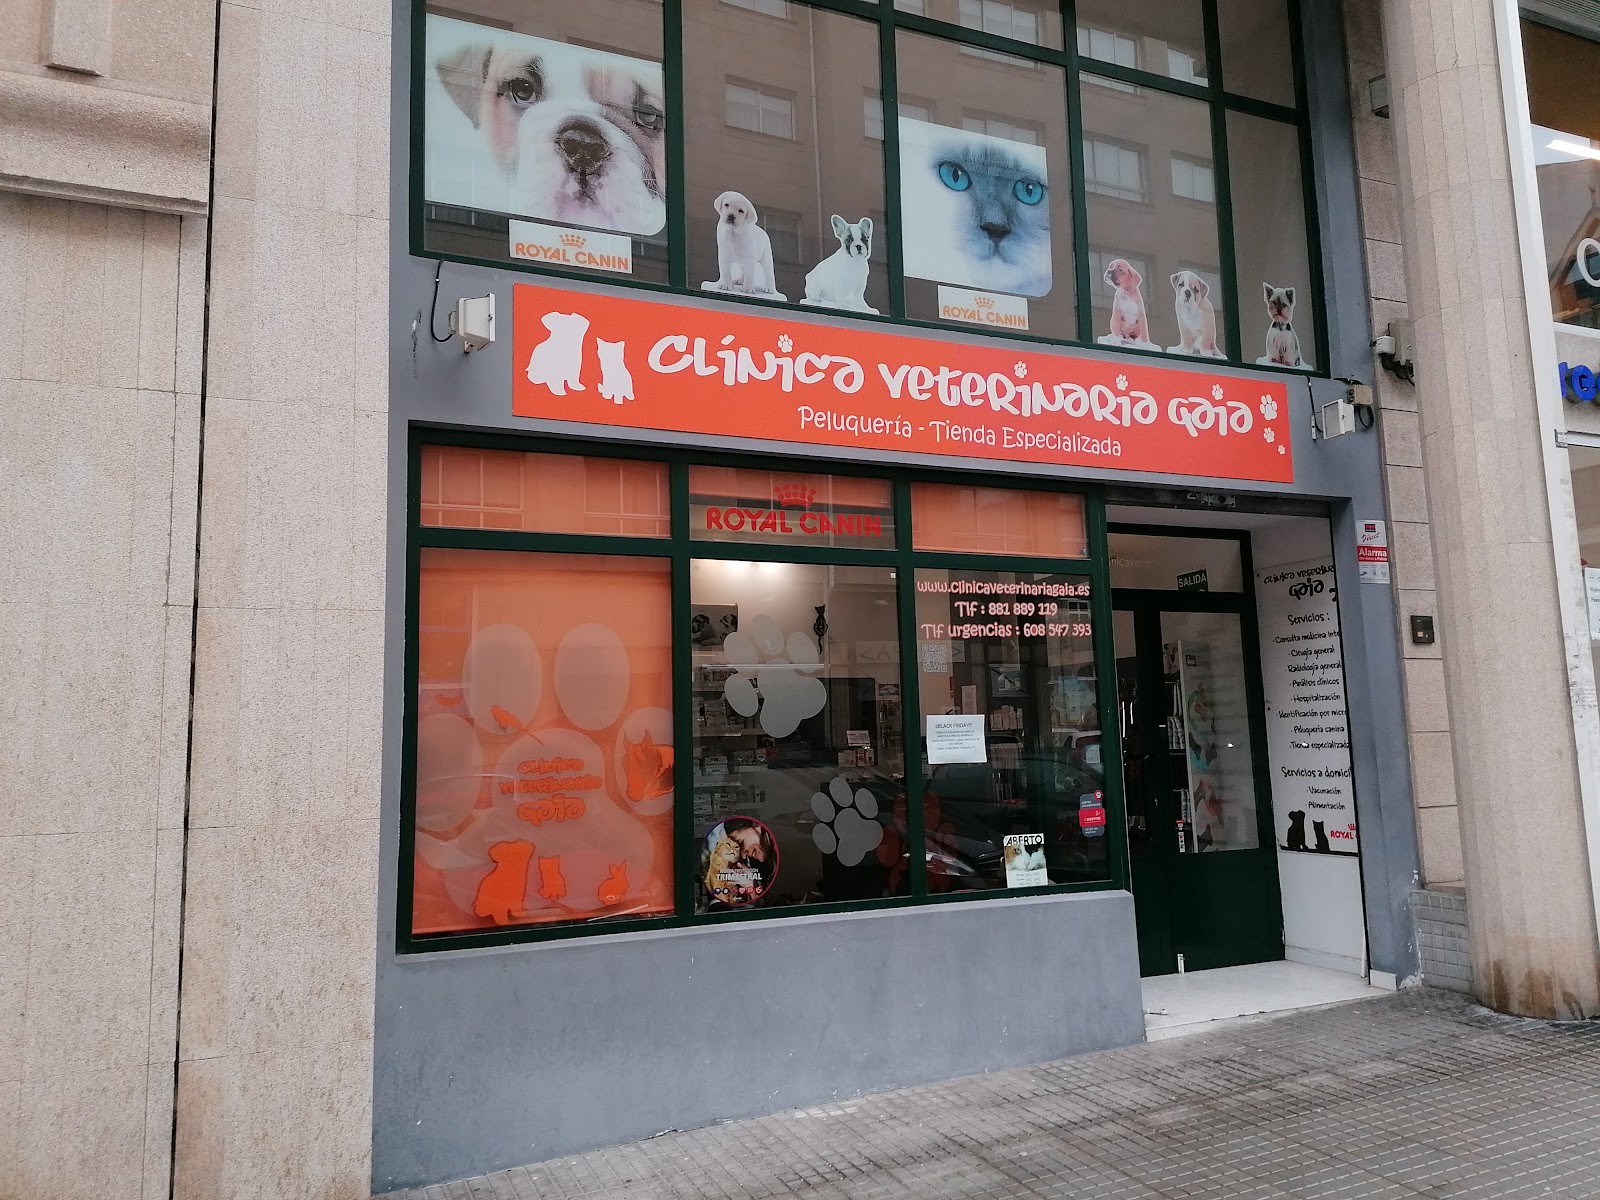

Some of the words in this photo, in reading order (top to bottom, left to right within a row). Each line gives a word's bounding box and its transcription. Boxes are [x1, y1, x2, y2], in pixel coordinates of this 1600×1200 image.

[515, 242, 570, 263] ROYAL
[575, 251, 629, 270] CANIN
[943, 305, 984, 322] ROYAL
[986, 311, 1026, 327] CANIN
[797, 405, 912, 438] Peluquería
[929, 420, 996, 447] Tienda
[1002, 426, 1122, 457] Especializada
[706, 506, 793, 534] ROYAL
[800, 511, 882, 537] CANIN
[1359, 548, 1387, 557] Alarma
[1178, 572, 1207, 588] SALIDA
[917, 581, 1091, 597] www.clinicaveterinariagaia.es
[988, 602, 1011, 616] 881
[1013, 602, 1035, 616] 889
[1038, 602, 1058, 616] 119
[1287, 612, 1325, 626] Servicios
[948, 621, 1013, 639] urgencias
[1023, 622, 1046, 636] 608
[1048, 623, 1069, 637] 547
[1072, 623, 1092, 637] 393
[1313, 644, 1335, 660] general
[1320, 660, 1342, 675] general
[1319, 711, 1330, 719] por
[1294, 725, 1324, 737] Peluquería
[1325, 725, 1345, 733] canina
[1281, 766, 1317, 778] Servicios
[1317, 769, 1323, 778] a
[1308, 786, 1342, 795] Vacunación
[1308, 801, 1346, 810] Alimentación
[1006, 834, 1043, 847] ABERTO
[1330, 830, 1354, 840] ROYAL
